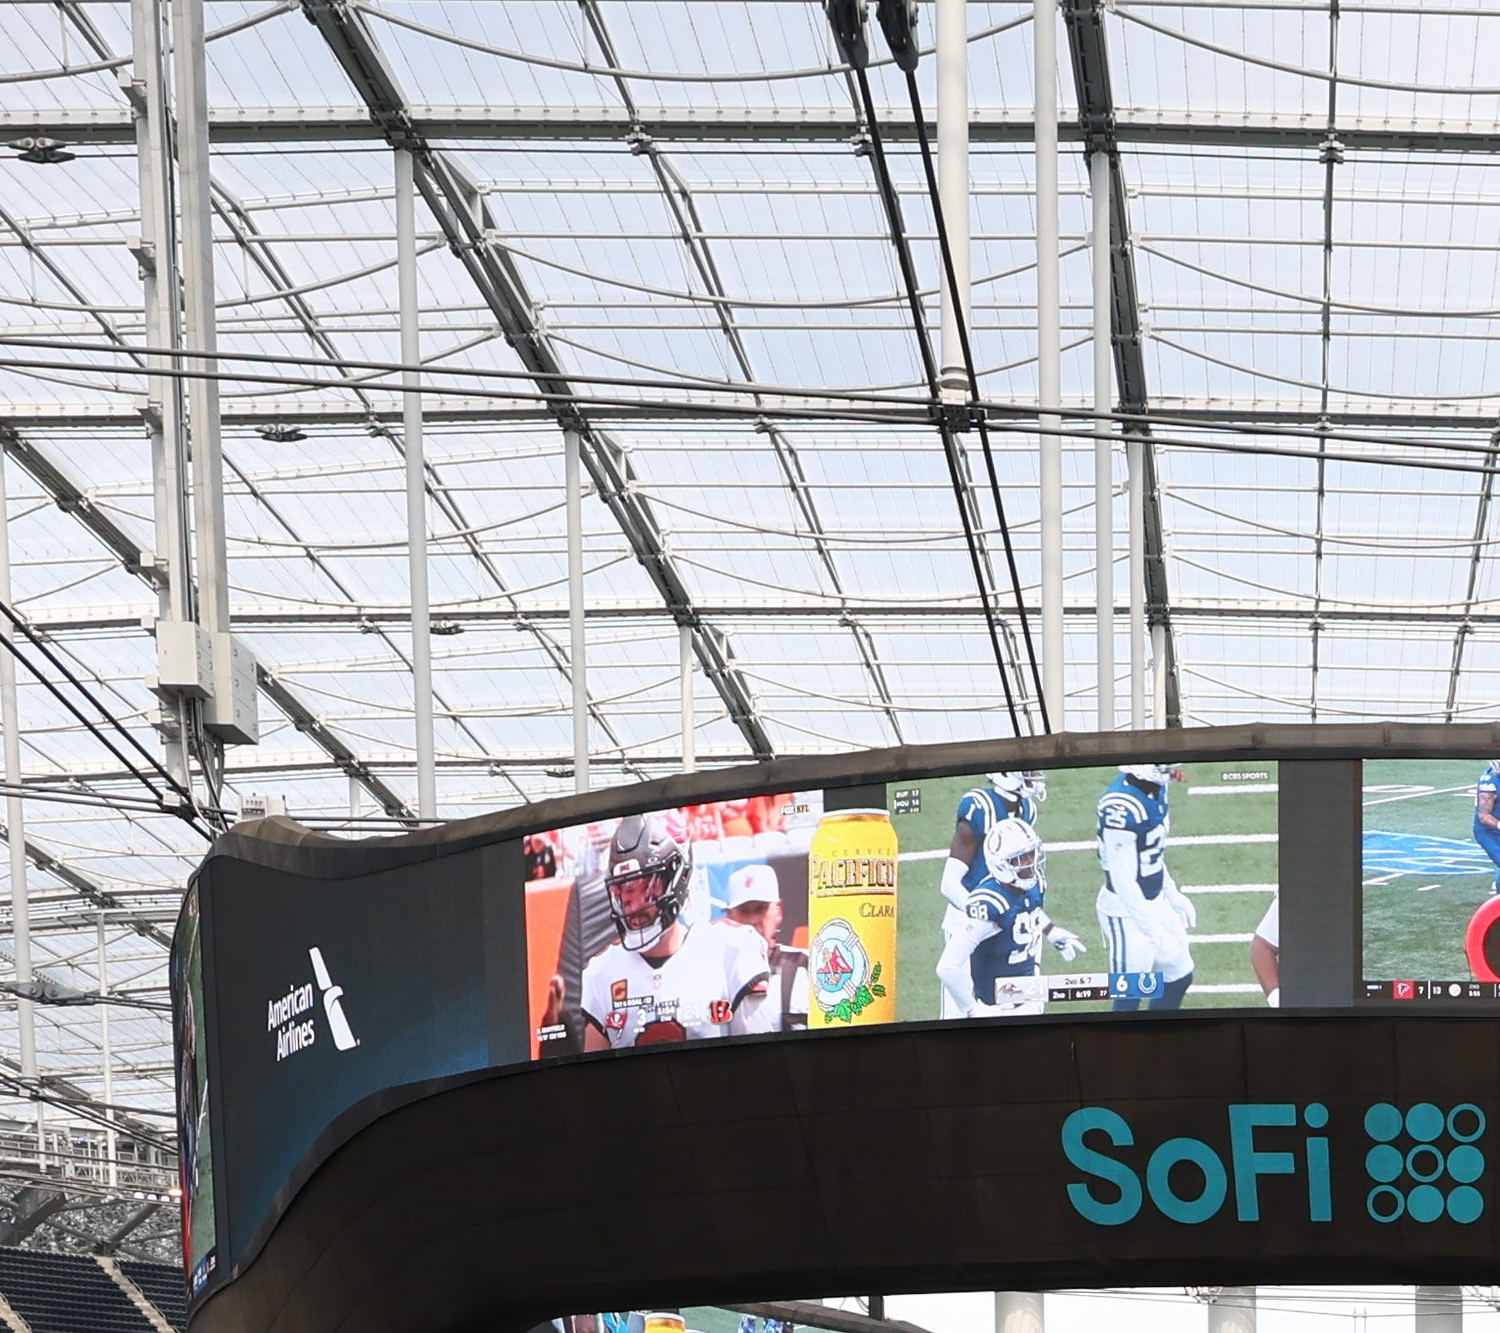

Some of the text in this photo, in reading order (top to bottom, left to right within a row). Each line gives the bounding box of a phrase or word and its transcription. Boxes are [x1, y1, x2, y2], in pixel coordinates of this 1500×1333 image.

[1242, 771, 1268, 780] SPORTS
[1104, 805, 1127, 828] 25
[1116, 974, 1128, 992] 6
[267, 982, 314, 1032] American
[637, 1009, 646, 1026] 3
[276, 1017, 315, 1062] Airlines
[1061, 1102, 1333, 1226] SoFi
